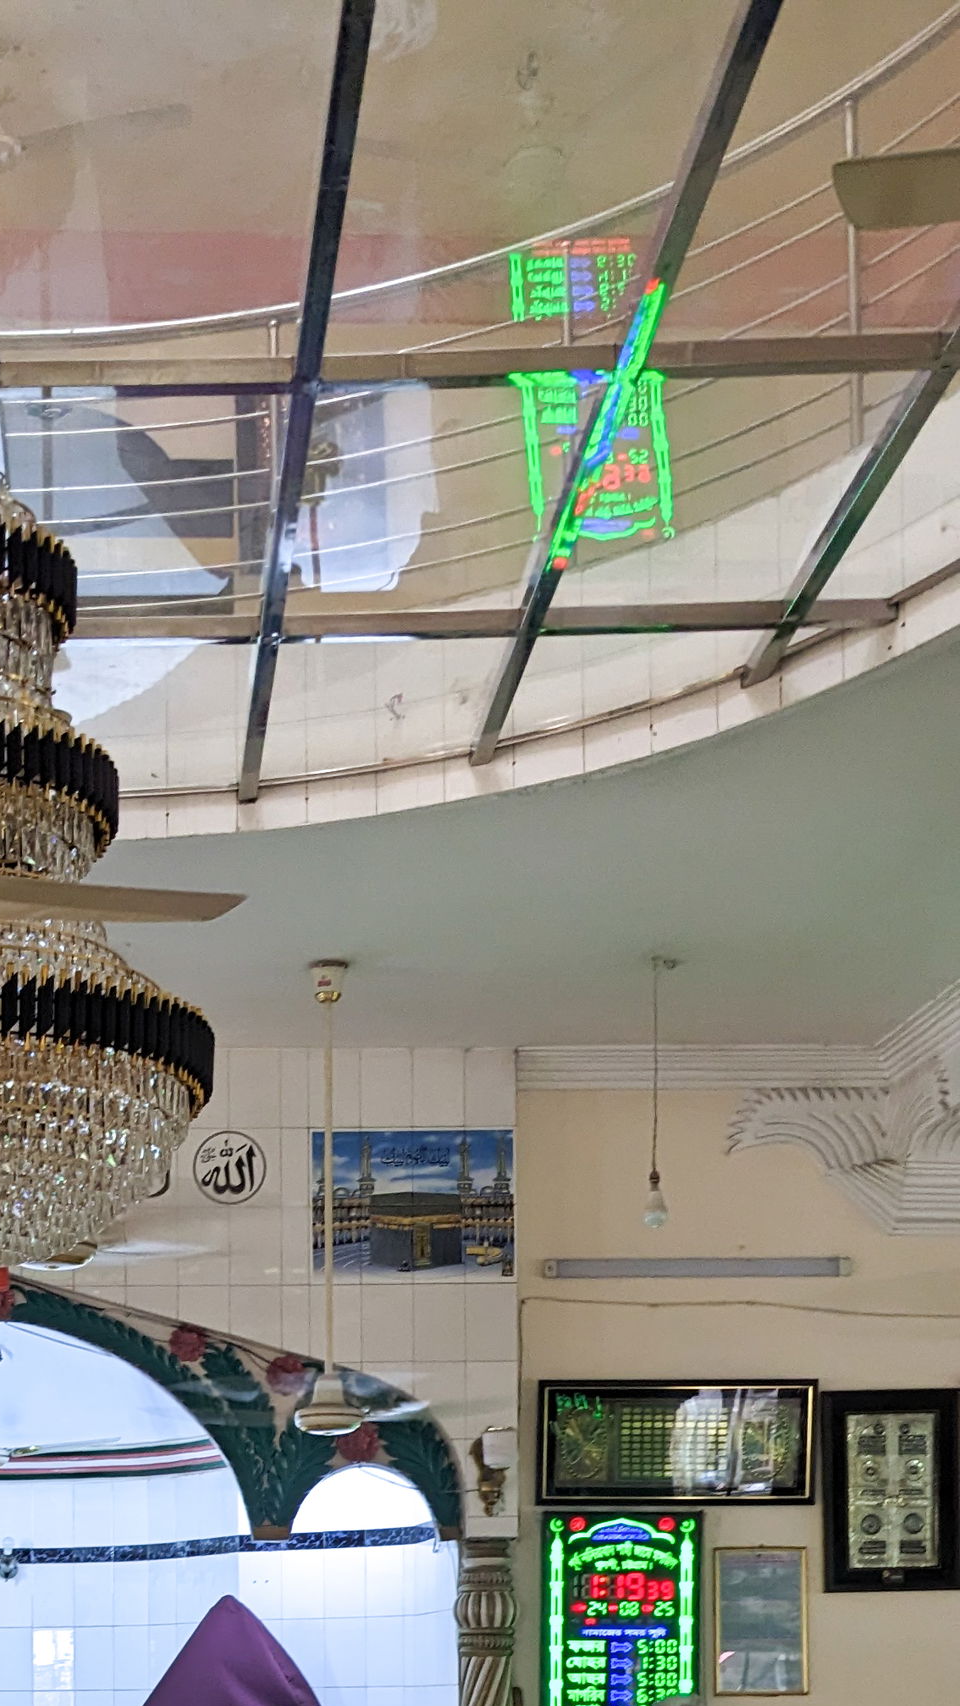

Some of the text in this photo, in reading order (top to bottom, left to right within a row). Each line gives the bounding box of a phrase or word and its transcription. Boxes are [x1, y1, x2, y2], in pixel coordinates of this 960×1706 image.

[201, 1139, 256, 1195] الله
[646, 1580, 675, 1600] 39
[587, 1601, 608, 1616] 24
[653, 1601, 675, 1616] 25
[637, 1639, 678, 1654] 5:00
[642, 1656, 678, 1670] 1:30
[637, 1672, 678, 1687] 5:00
